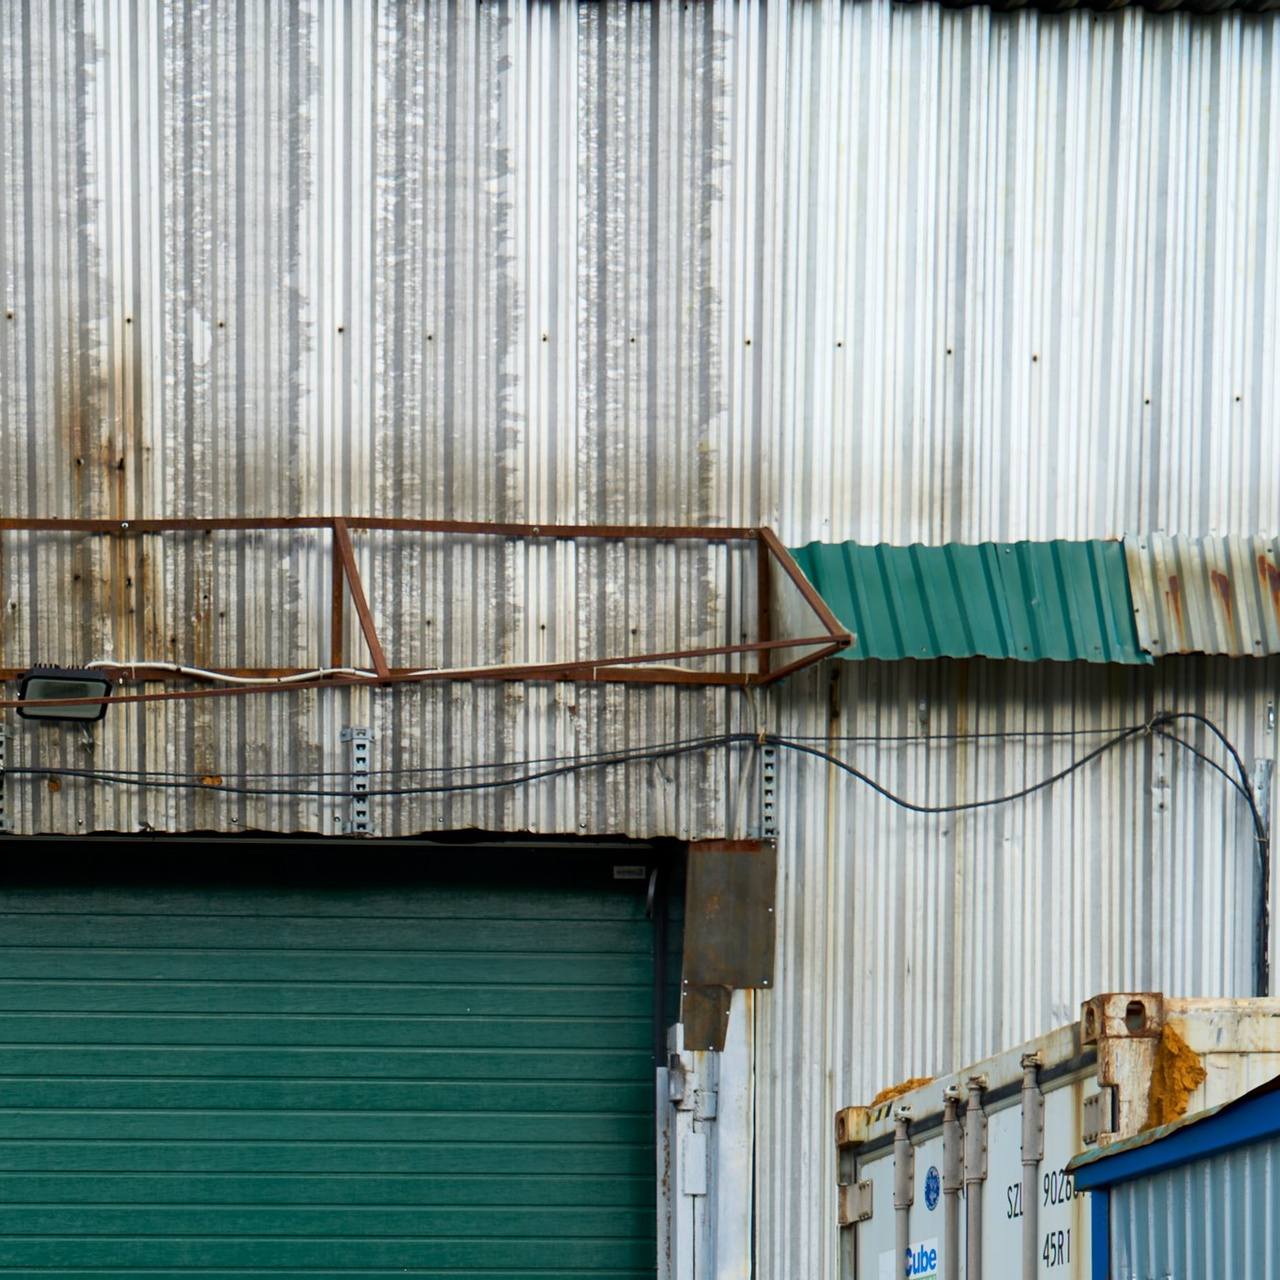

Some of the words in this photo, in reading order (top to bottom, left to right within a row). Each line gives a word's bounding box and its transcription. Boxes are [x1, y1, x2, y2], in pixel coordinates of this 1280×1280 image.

[1007, 1182, 1023, 1219] SZL
[1043, 1168, 1085, 1207] 9026
[905, 1244, 937, 1277] Cube
[1042, 1228, 1071, 1268] 45R1
